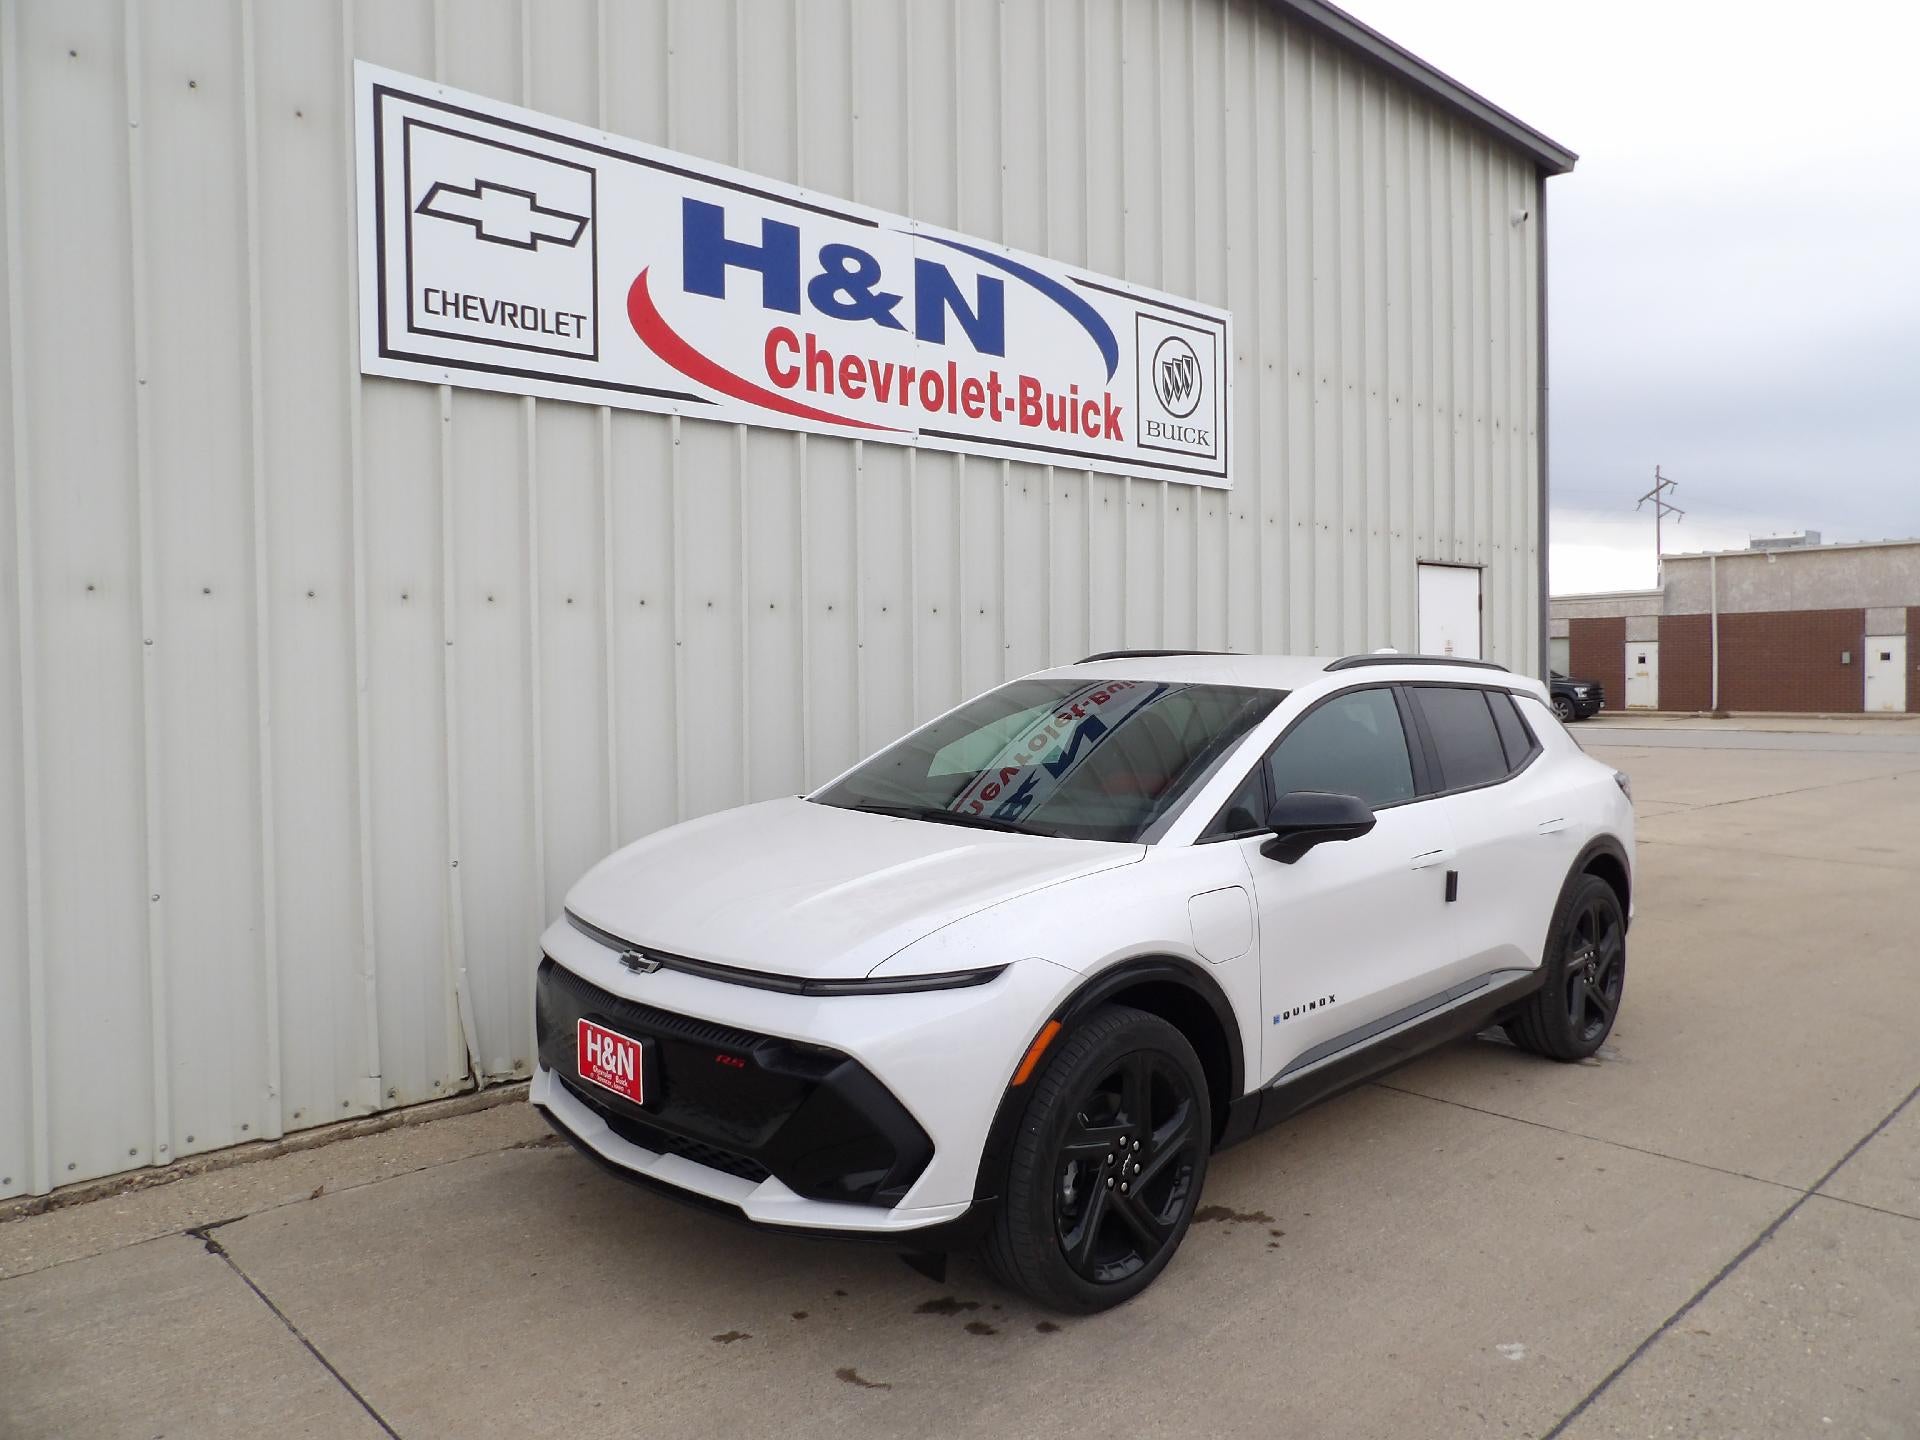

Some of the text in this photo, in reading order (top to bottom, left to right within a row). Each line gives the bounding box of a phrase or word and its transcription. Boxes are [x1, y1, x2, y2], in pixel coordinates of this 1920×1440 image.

[683, 197, 1005, 355] H&N
[424, 287, 588, 339] CHEVROLET
[765, 326, 1124, 441] Chevrolet-Buick
[1146, 419, 1211, 447] BUICK
[1273, 993, 1336, 1025] EQUINOX
[587, 1029, 634, 1081] H&N
